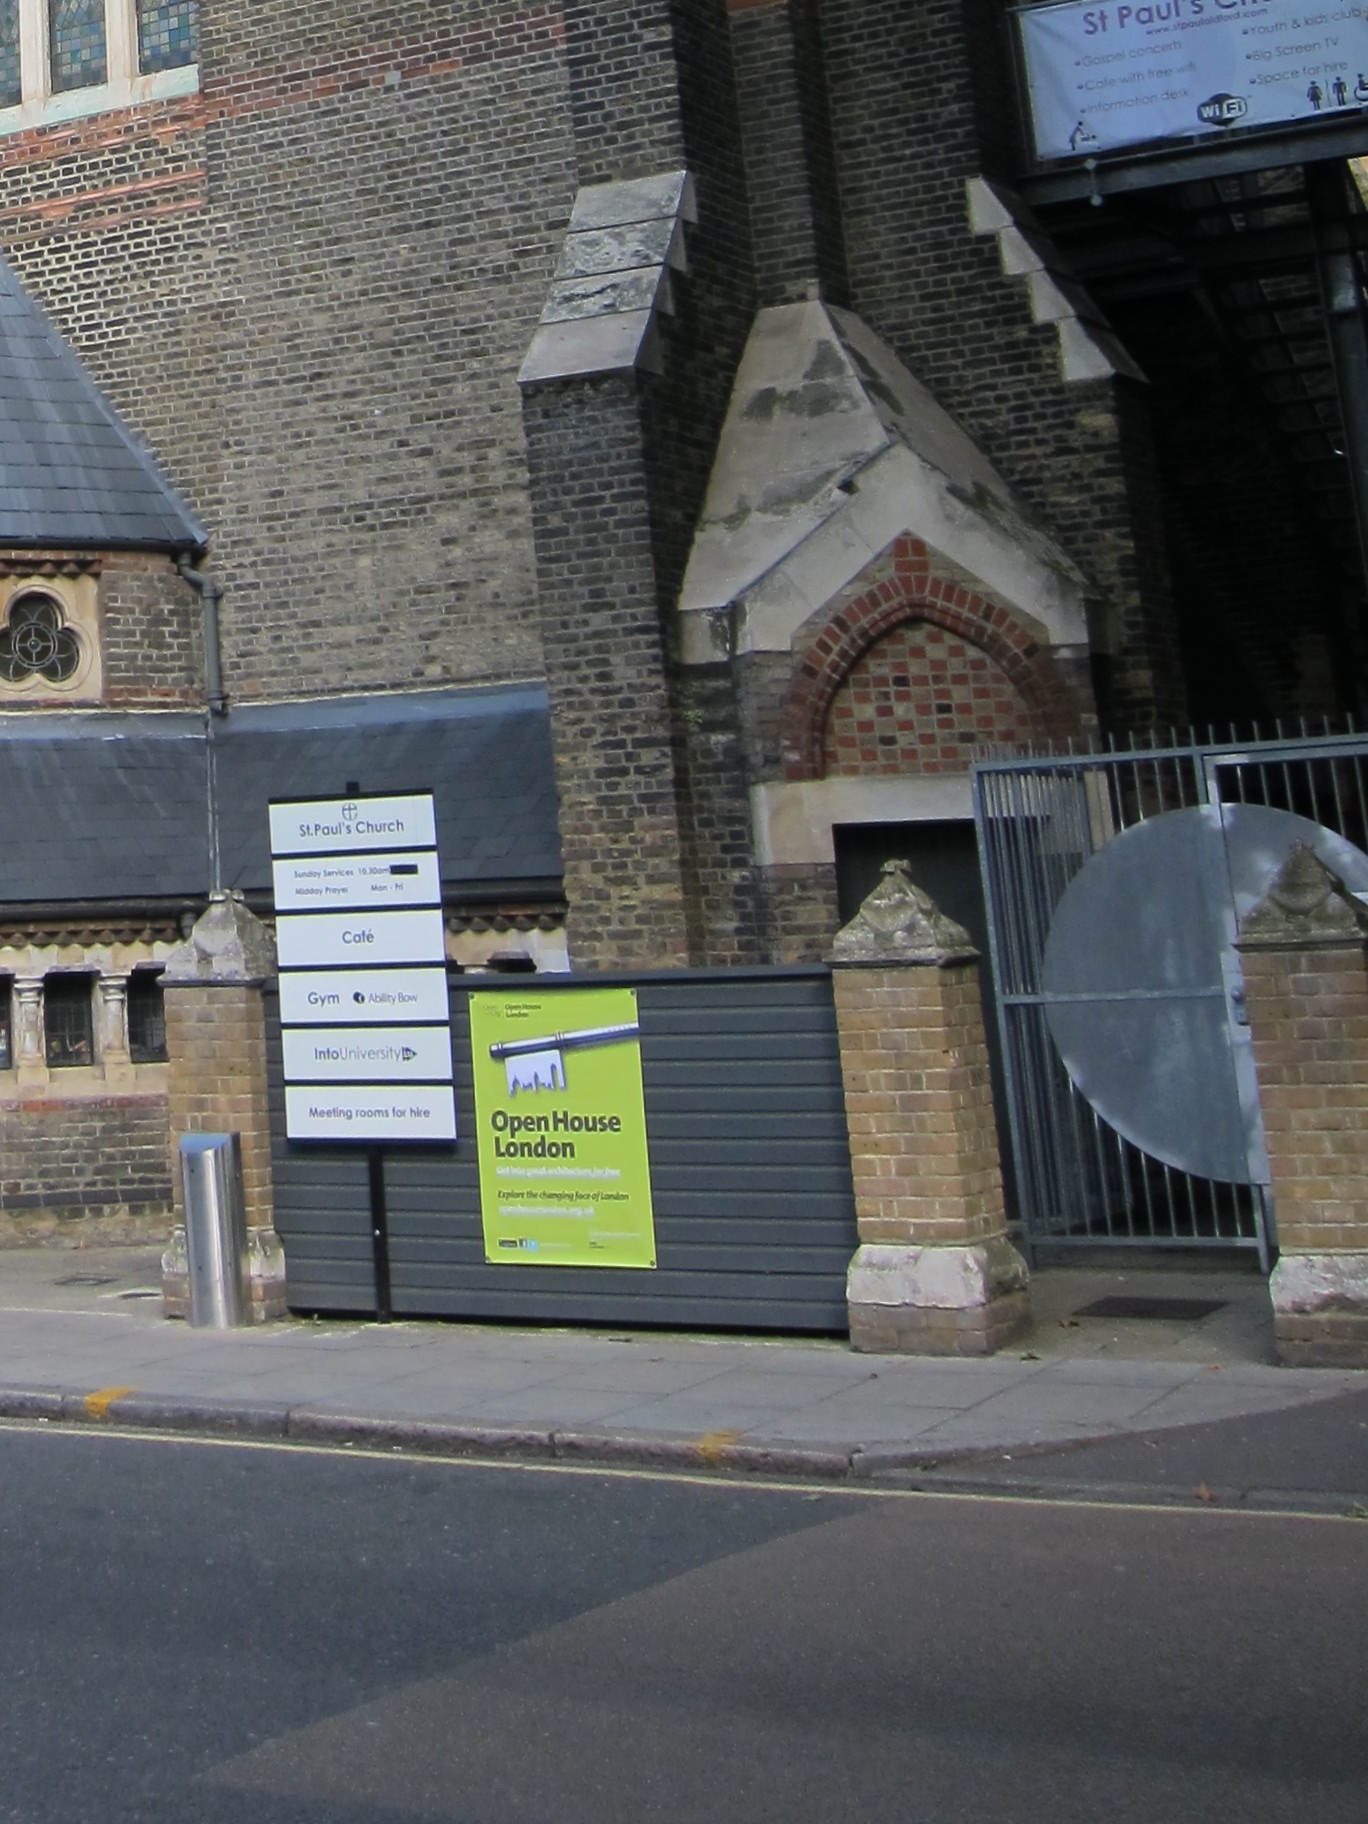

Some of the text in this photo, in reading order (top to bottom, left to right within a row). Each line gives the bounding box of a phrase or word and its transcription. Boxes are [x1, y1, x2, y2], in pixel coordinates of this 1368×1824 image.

[1083, 10, 1107, 35] St
[1250, 22, 1287, 35] Youth
[1292, 18, 1301, 29] &
[1304, 14, 1328, 26] kids
[1253, 37, 1339, 61] Big Screen TV
[1120, 72, 1144, 84] with
[1148, 68, 1172, 79] free
[1257, 60, 1348, 85] Space for hire
[1087, 95, 1158, 113] Information
[355, 819, 404, 835] Church
[294, 870, 321, 879] Sunday
[323, 868, 354, 878] Services
[295, 887, 323, 896] Midday
[325, 886, 348, 895] Prayer
[371, 883, 388, 892] Mon
[342, 928, 374, 944] Café
[307, 991, 418, 1007] Gym Ability Bow
[314, 1046, 402, 1062] IntoUniversity
[309, 1106, 430, 1120] Meeting rooms for hire
[491, 1110, 621, 1139] Open House
[494, 1135, 575, 1158] London
